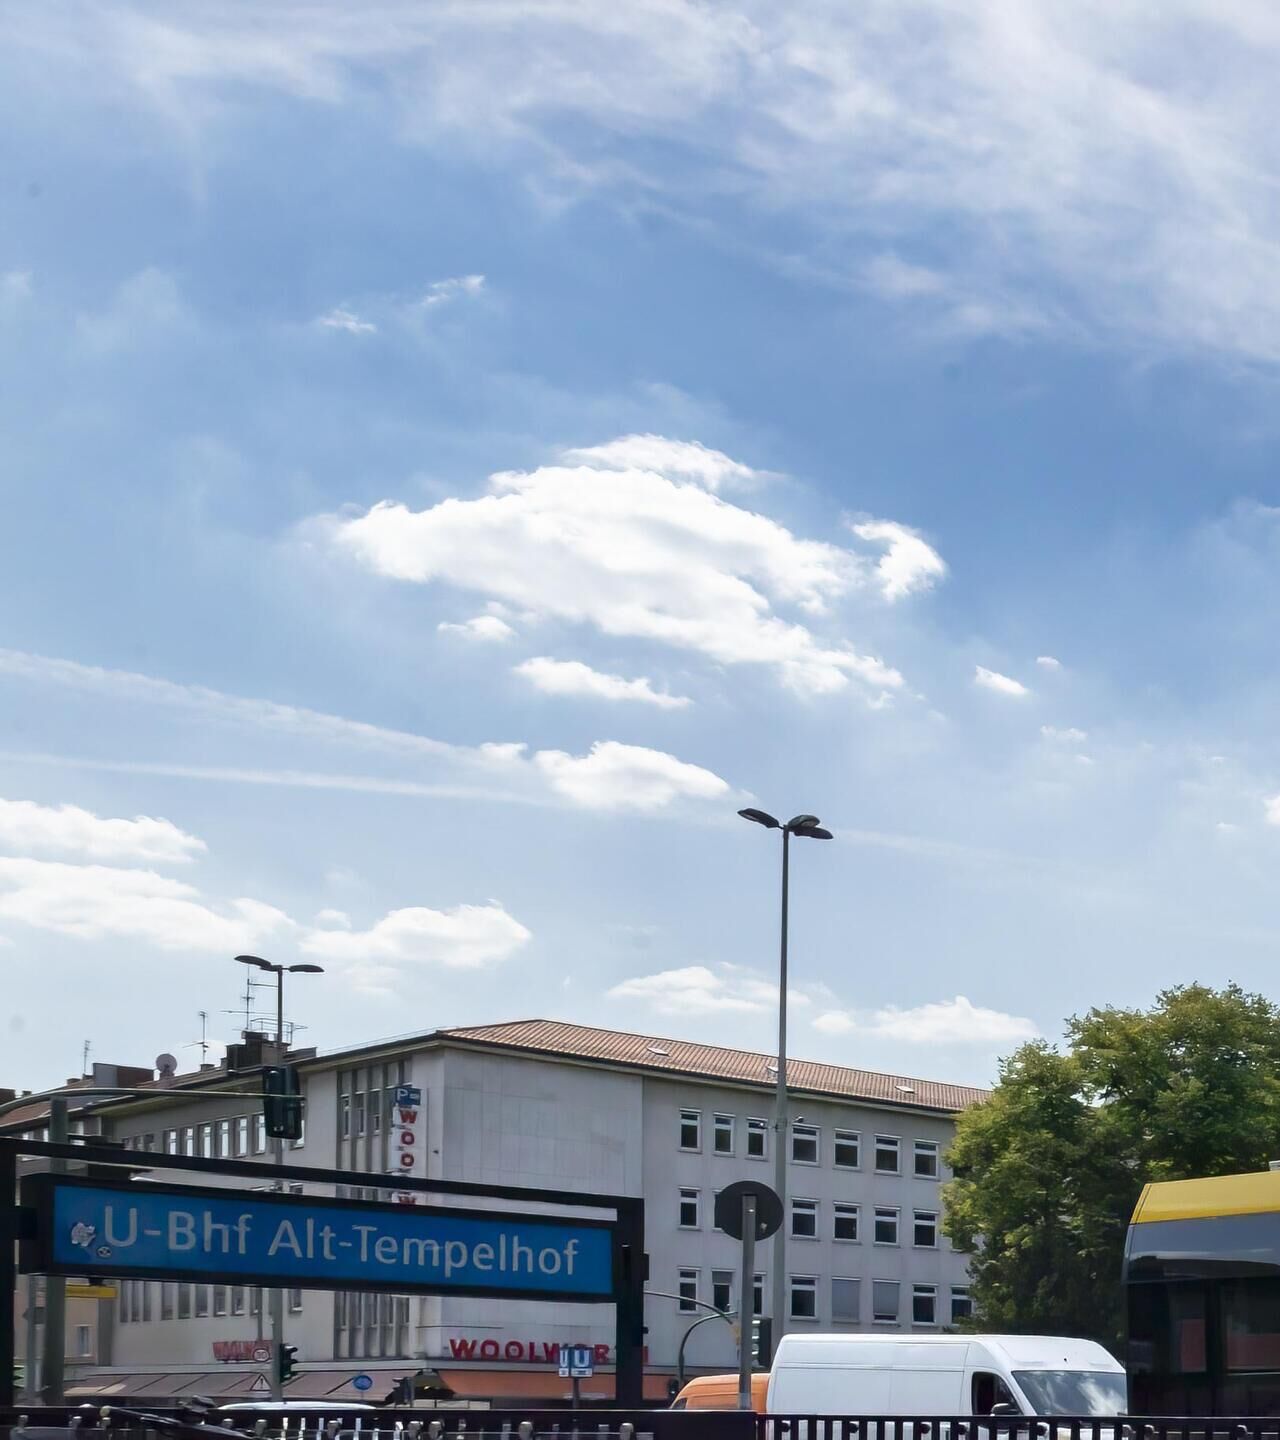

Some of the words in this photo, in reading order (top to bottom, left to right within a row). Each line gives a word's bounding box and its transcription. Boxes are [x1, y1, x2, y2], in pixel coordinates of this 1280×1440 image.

[104, 1205, 253, 1255] U-Bhf
[267, 1216, 579, 1278] Alt-Tempelhof
[449, 1338, 648, 1362] WOOLWR
[574, 1350, 589, 1368] U
